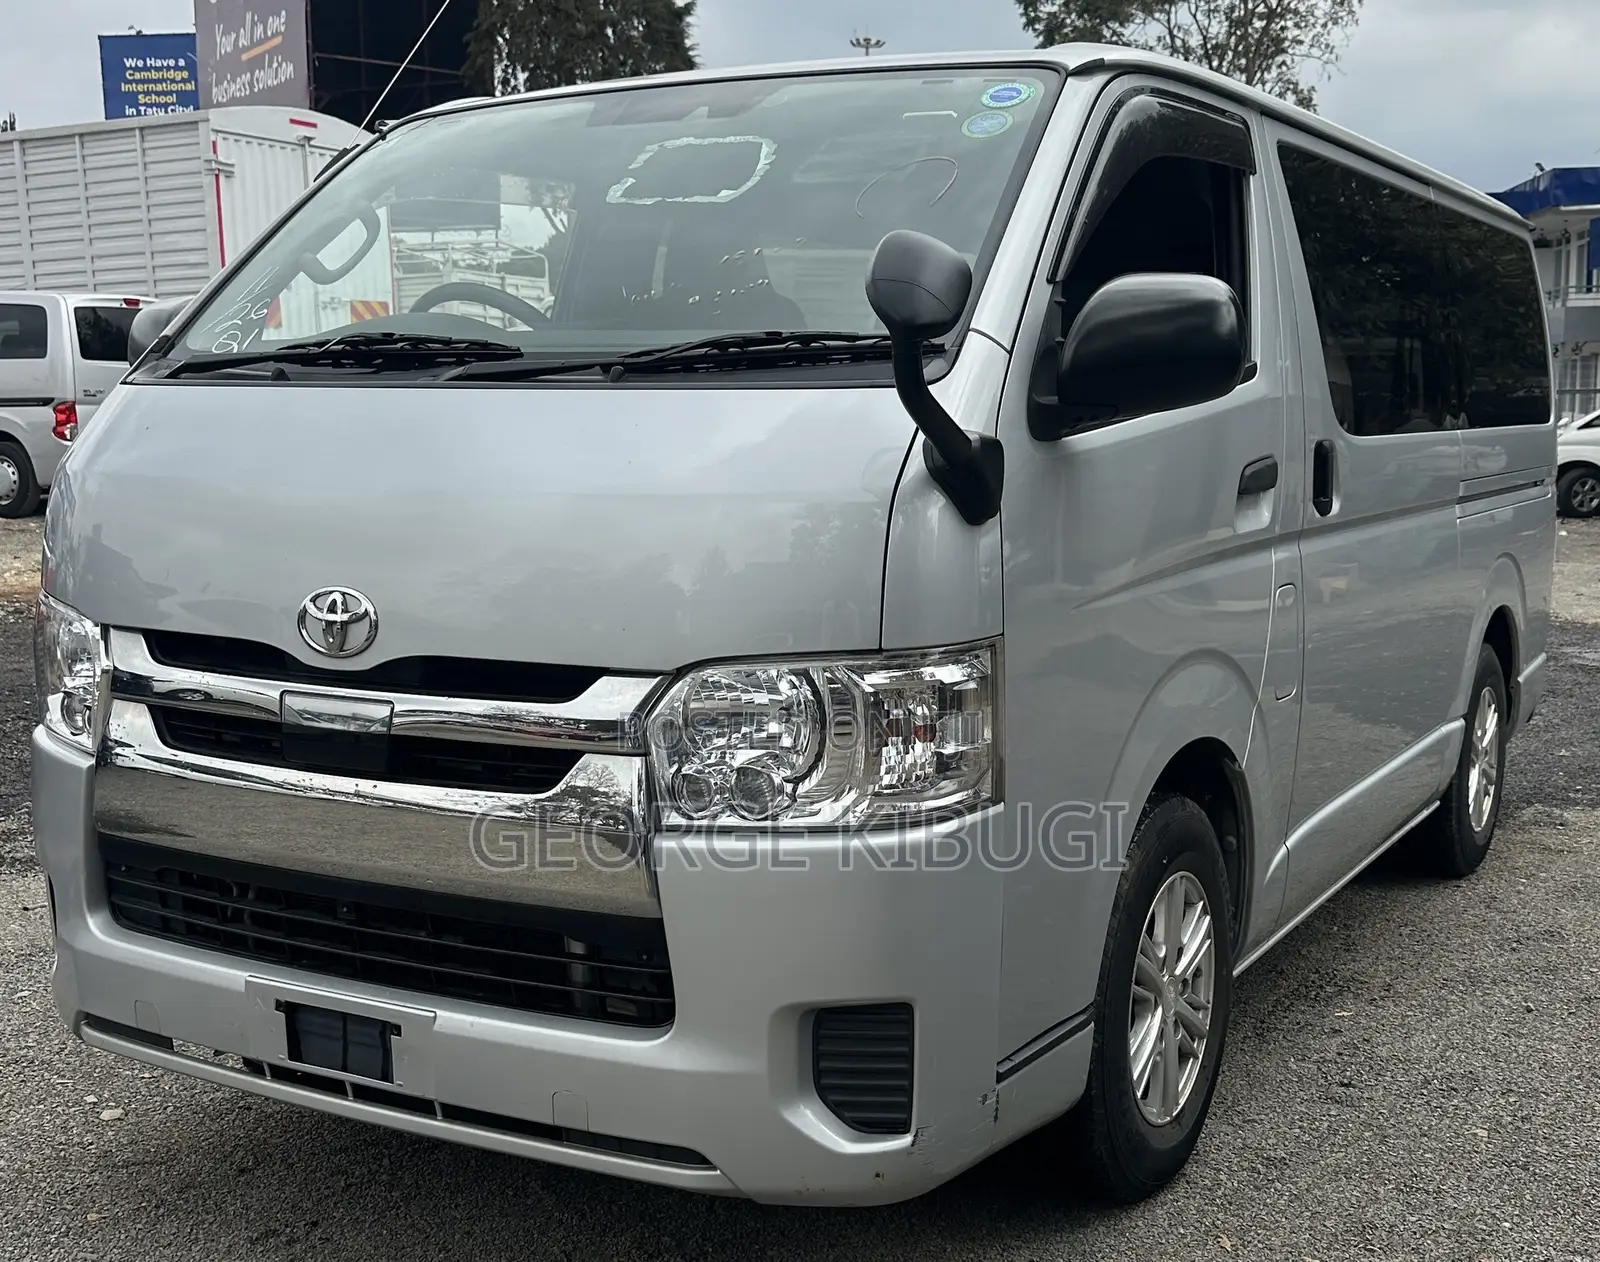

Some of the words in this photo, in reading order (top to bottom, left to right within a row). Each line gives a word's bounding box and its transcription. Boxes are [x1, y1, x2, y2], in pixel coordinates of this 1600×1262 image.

[215, 23, 236, 60] Your
[239, 11, 252, 48] all
[253, 13, 264, 42] in
[266, 10, 287, 37] one
[123, 57, 144, 68] We
[146, 57, 176, 67] Have
[178, 58, 186, 66] a
[125, 68, 189, 81] Cambridge
[212, 72, 251, 104] business
[253, 53, 294, 93] solution
[121, 80, 196, 92] International
[138, 92, 177, 104] School
[125, 105, 137, 116] in
[138, 106, 166, 116] Tatu
